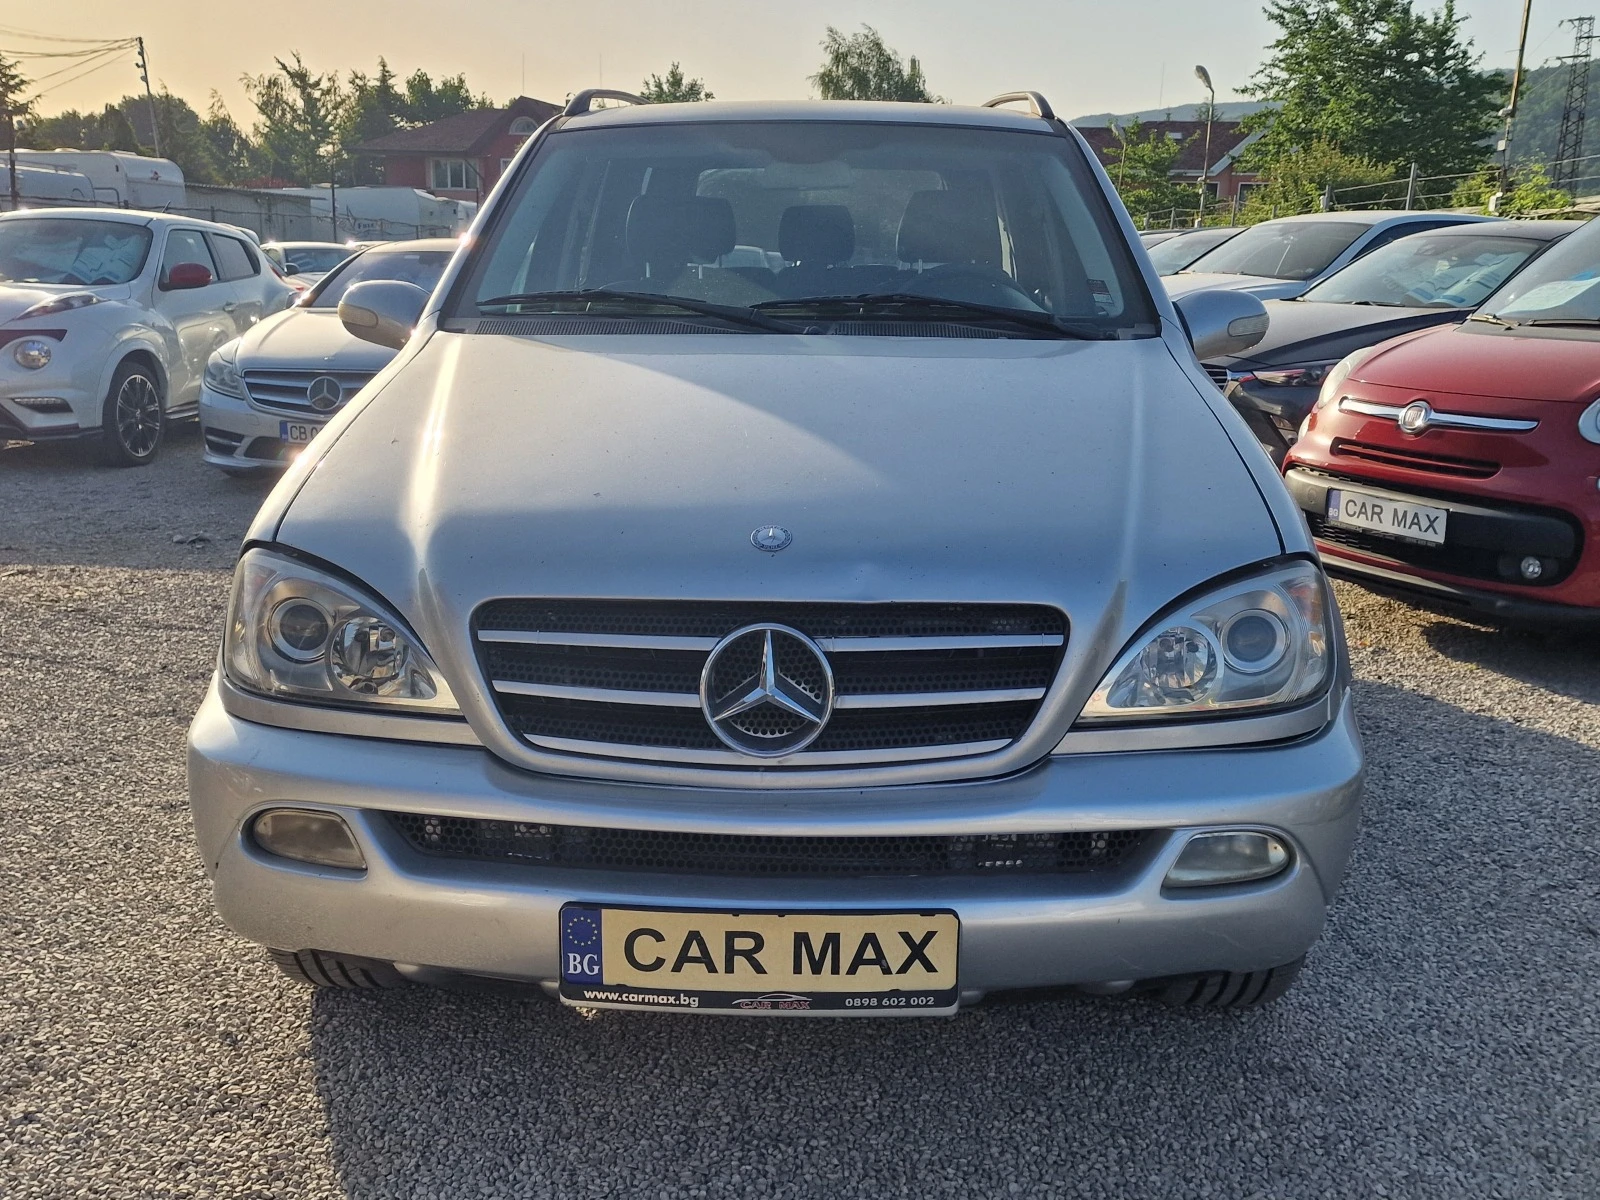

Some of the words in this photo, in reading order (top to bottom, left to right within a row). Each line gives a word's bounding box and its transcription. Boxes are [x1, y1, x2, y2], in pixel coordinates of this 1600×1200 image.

[290, 425, 308, 441] CB
[1328, 507, 1338, 517] BG
[1345, 499, 1384, 524] CAR
[1391, 507, 1440, 535] MAX
[623, 927, 768, 975] CAR
[792, 930, 939, 976] MAX
[567, 952, 600, 975] BG
[584, 989, 699, 1008] www.carmax.bg
[740, 1001, 772, 1010] CAR
[778, 1001, 811, 1010] MAX
[845, 998, 878, 1007] 0898
[881, 998, 906, 1007] 602
[910, 996, 935, 1006] 002
